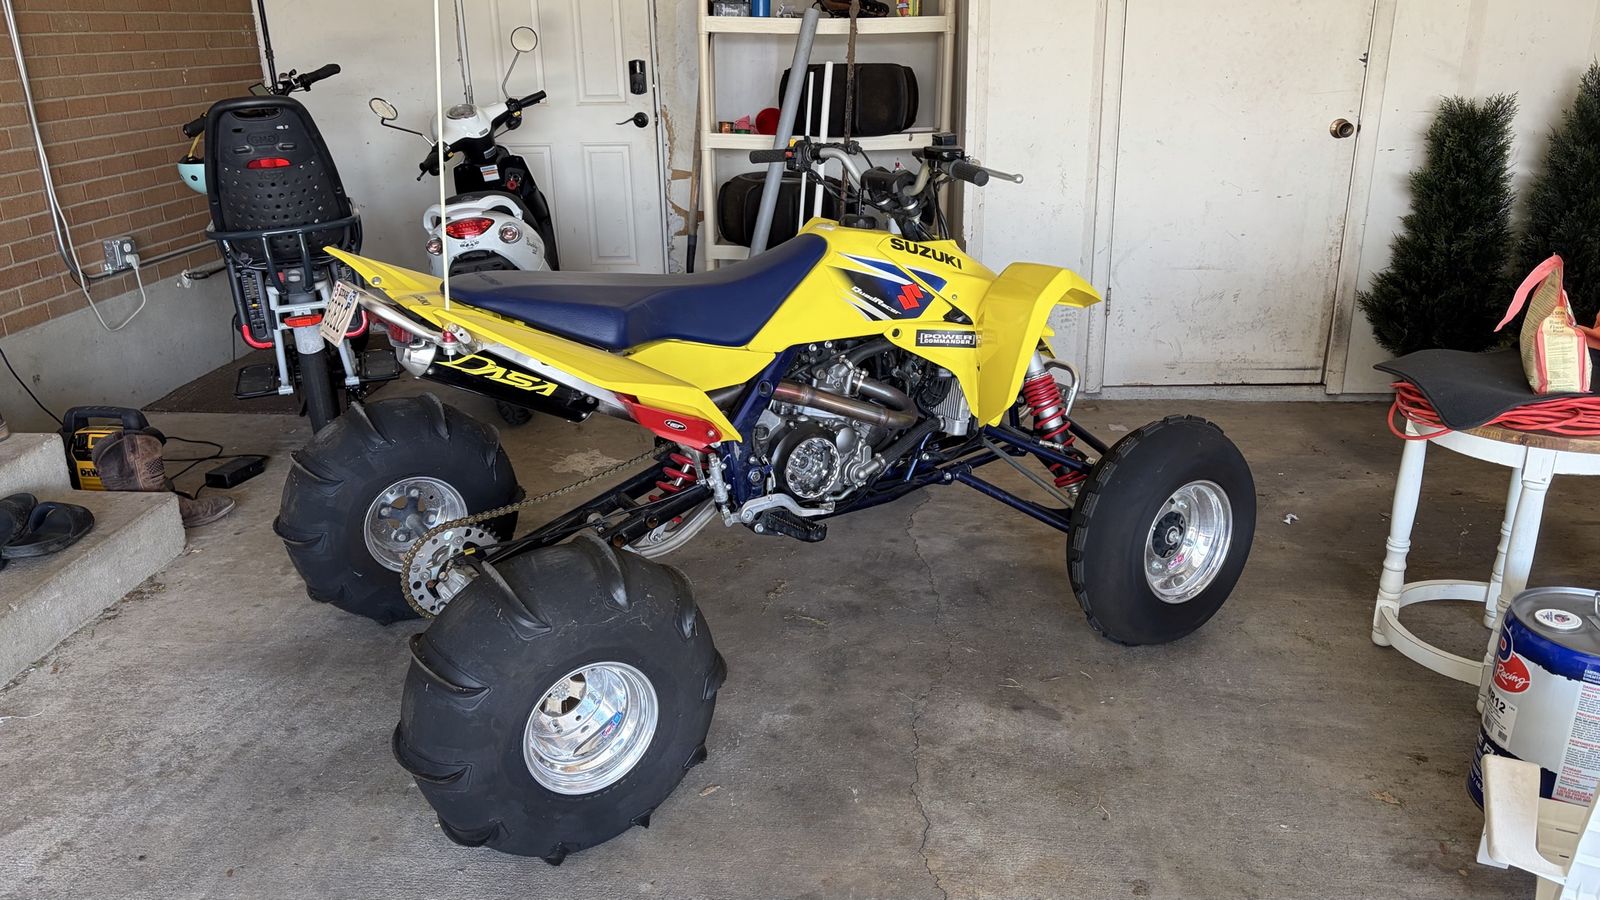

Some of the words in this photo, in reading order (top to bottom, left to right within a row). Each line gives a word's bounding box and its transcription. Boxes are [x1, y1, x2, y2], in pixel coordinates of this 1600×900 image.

[890, 238, 962, 270] SUZUKI
[851, 285, 902, 315] QuadRacer
[434, 354, 559, 397] DASA
[81, 469, 99, 477] DEW
[1496, 663, 1530, 689] Racing
